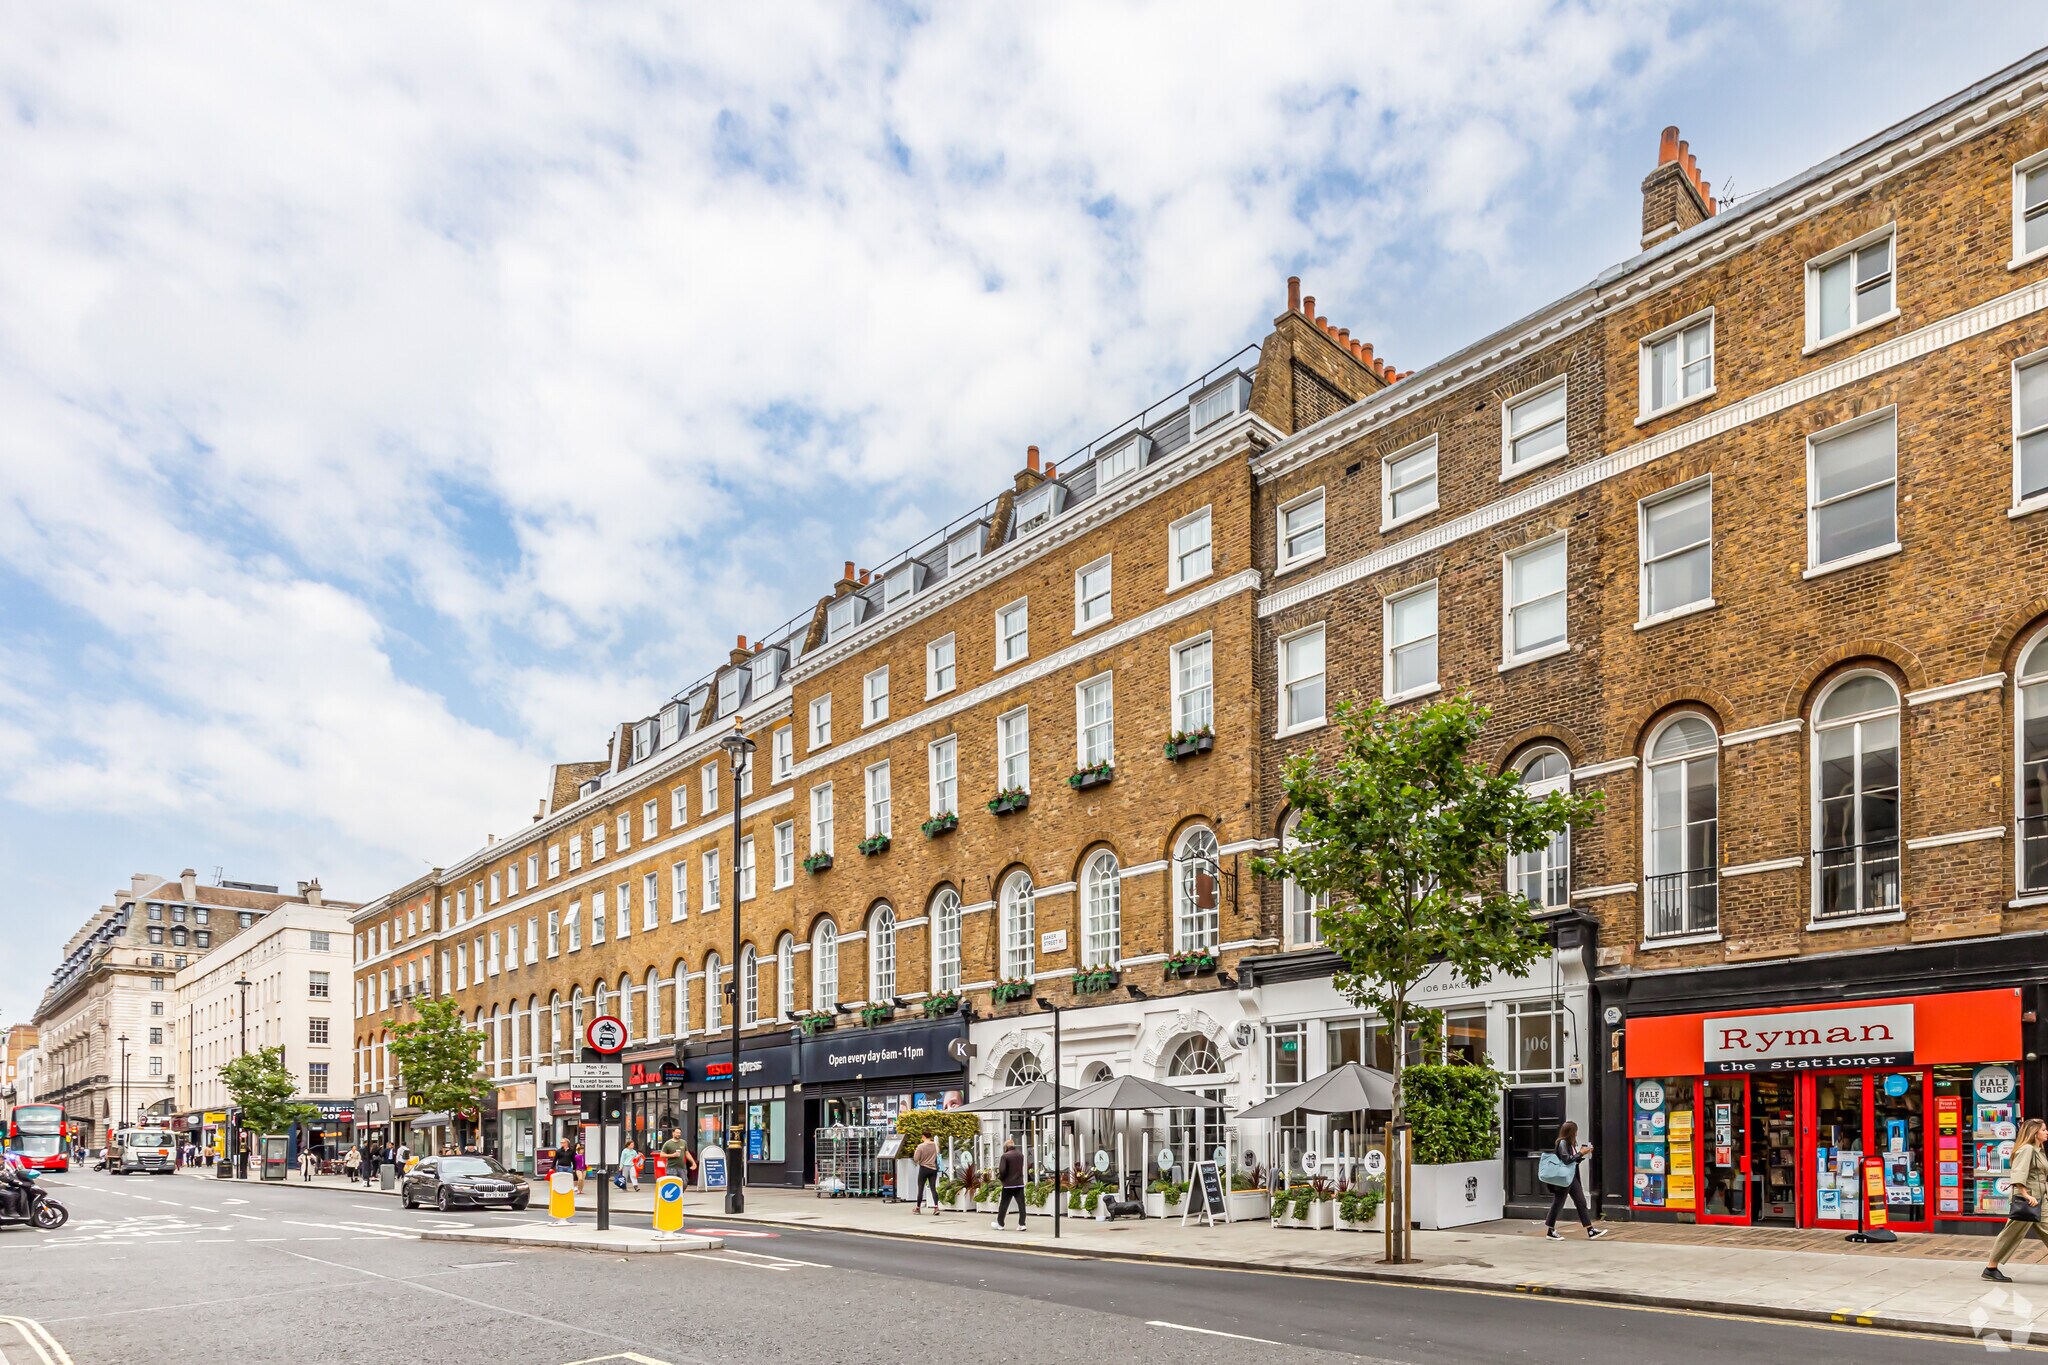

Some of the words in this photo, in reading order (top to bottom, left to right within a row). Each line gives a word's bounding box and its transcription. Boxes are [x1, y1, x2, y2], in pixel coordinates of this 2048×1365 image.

[1044, 939, 1058, 947] STREET
[1423, 985, 1439, 993] 106
[1442, 981, 1470, 991] BAKE
[1524, 1036, 1549, 1051] 106
[1719, 1024, 1894, 1053] Ryman
[829, 1053, 848, 1067] Open
[847, 1052, 867, 1065] every
[867, 1049, 881, 1064] day
[881, 1048, 898, 1061] 6am
[903, 1046, 924, 1060] 11pm
[956, 1043, 968, 1057] K
[706, 1062, 732, 1075] TESCO
[739, 1061, 763, 1077] xpress
[1719, 1062, 1756, 1072] the
[1771, 1055, 1896, 1069] stationer
[1980, 1079, 2009, 1087] HALF
[1980, 1086, 2009, 1094] PRICE
